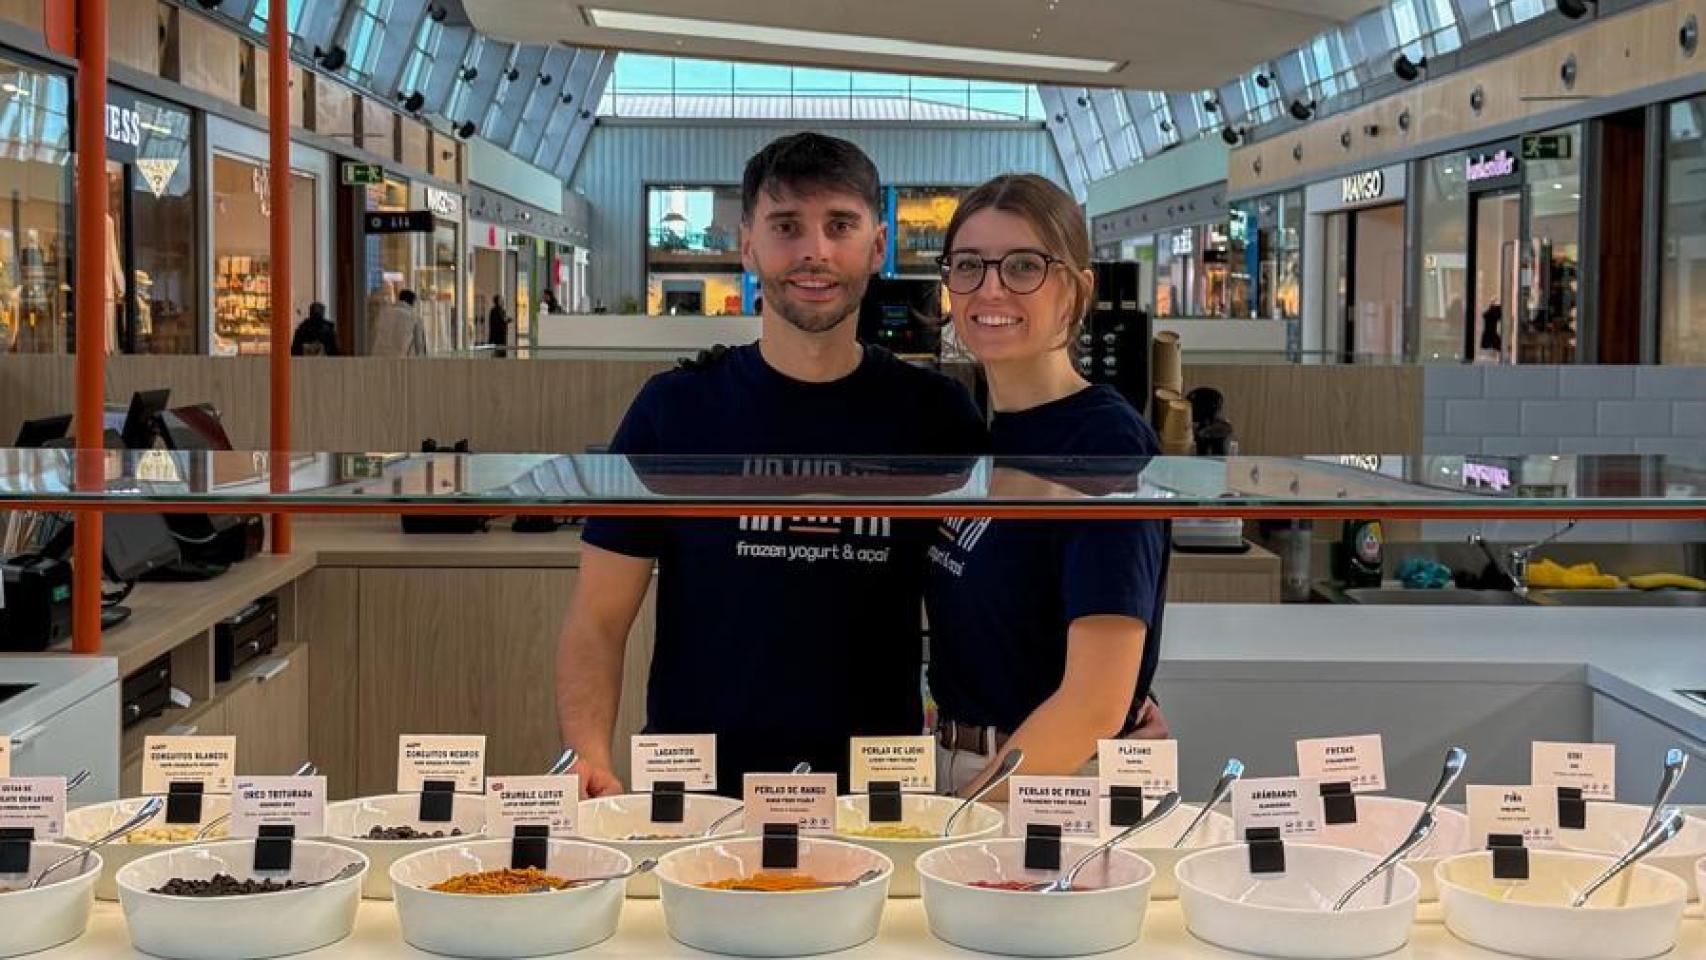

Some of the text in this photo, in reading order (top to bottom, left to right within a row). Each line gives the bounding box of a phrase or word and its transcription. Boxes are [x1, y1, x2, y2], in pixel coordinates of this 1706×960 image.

[104, 103, 139, 147] ESS
[1342, 170, 1382, 202] MANGO
[736, 541, 786, 558] frozen
[788, 544, 839, 562] yogurt
[842, 543, 854, 560] &
[754, 786, 785, 794] PERLAS
[787, 786, 798, 794] DE
[1018, 786, 1050, 796] PERLAS
